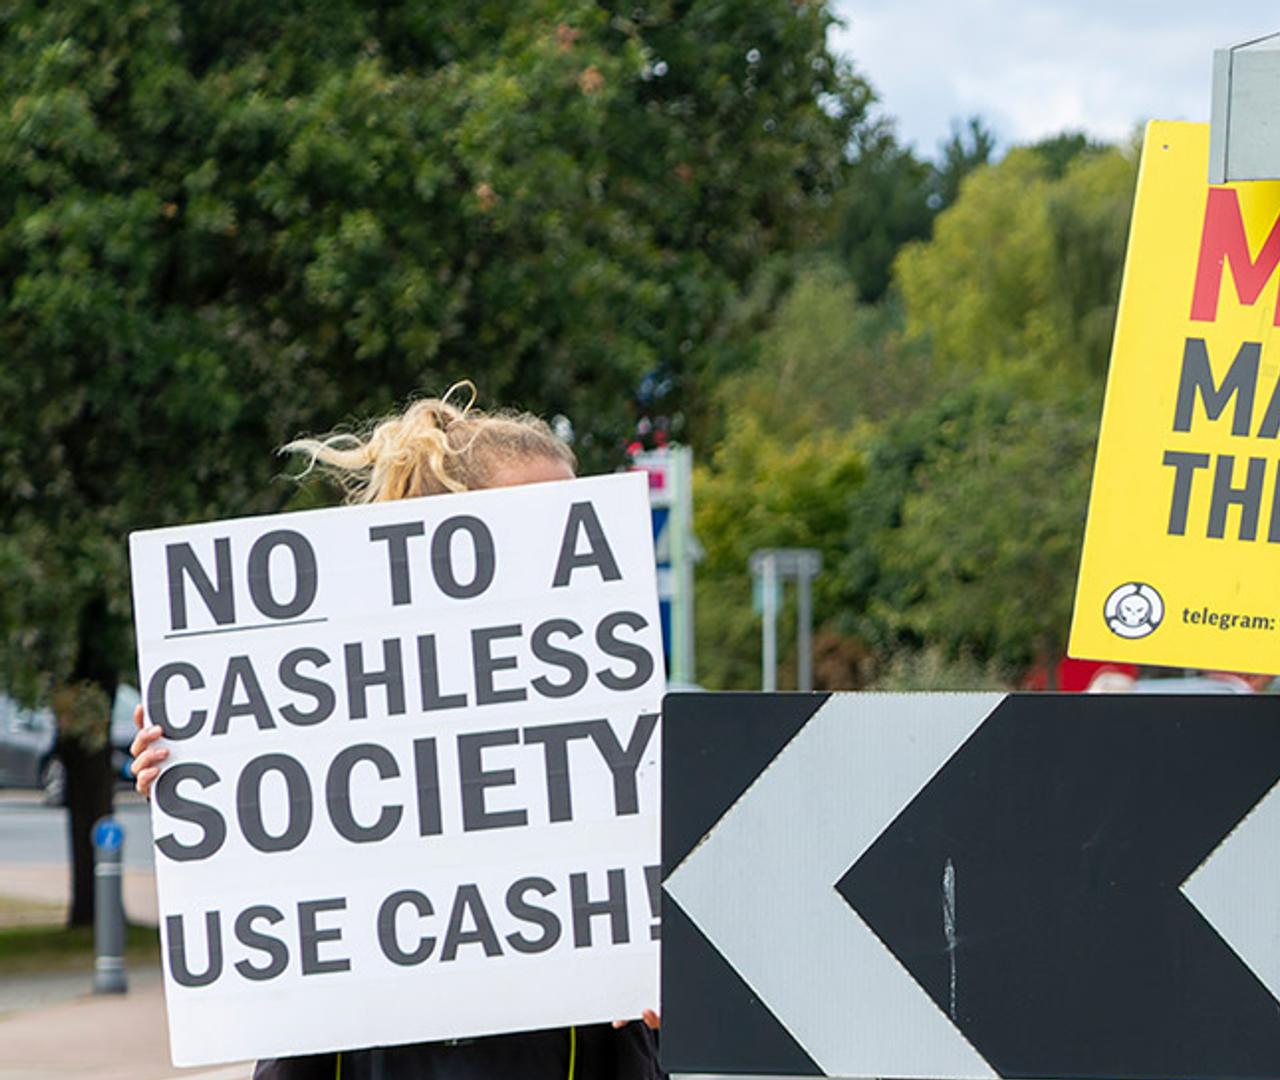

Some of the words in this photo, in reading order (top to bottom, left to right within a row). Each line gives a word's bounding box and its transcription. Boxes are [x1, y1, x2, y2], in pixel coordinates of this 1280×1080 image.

[165, 529, 318, 631] NO
[369, 515, 496, 606] TO
[552, 501, 623, 588] A
[1182, 607, 1275, 630] telegram:
[147, 611, 654, 740] CASHLESS
[154, 712, 661, 862] SOCIETY
[166, 897, 351, 988] USE
[377, 866, 661, 967] CASH!
